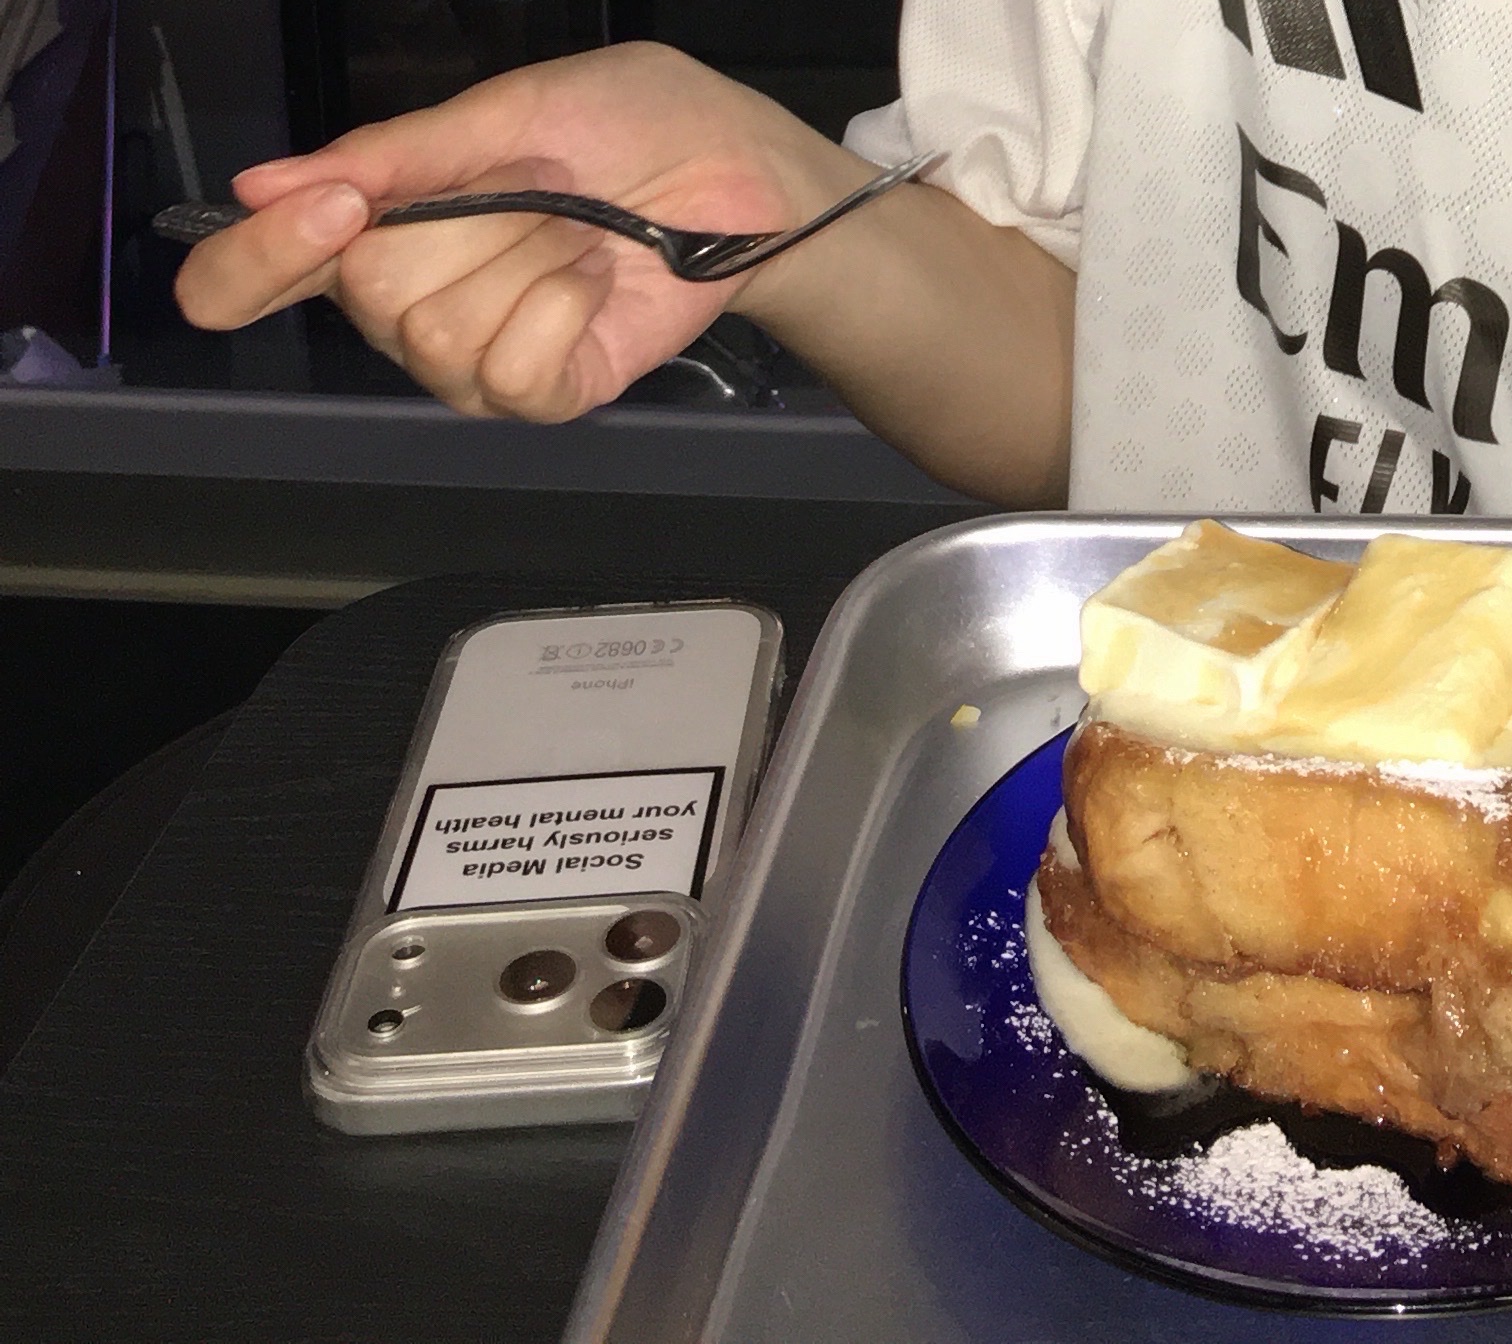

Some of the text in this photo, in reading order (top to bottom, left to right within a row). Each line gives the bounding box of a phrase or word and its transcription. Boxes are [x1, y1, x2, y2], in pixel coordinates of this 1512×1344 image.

[571, 677, 635, 692] iPhone
[434, 800, 699, 835] your mental health
[445, 828, 675, 856] seriously harms
[462, 852, 645, 880] Social Media
